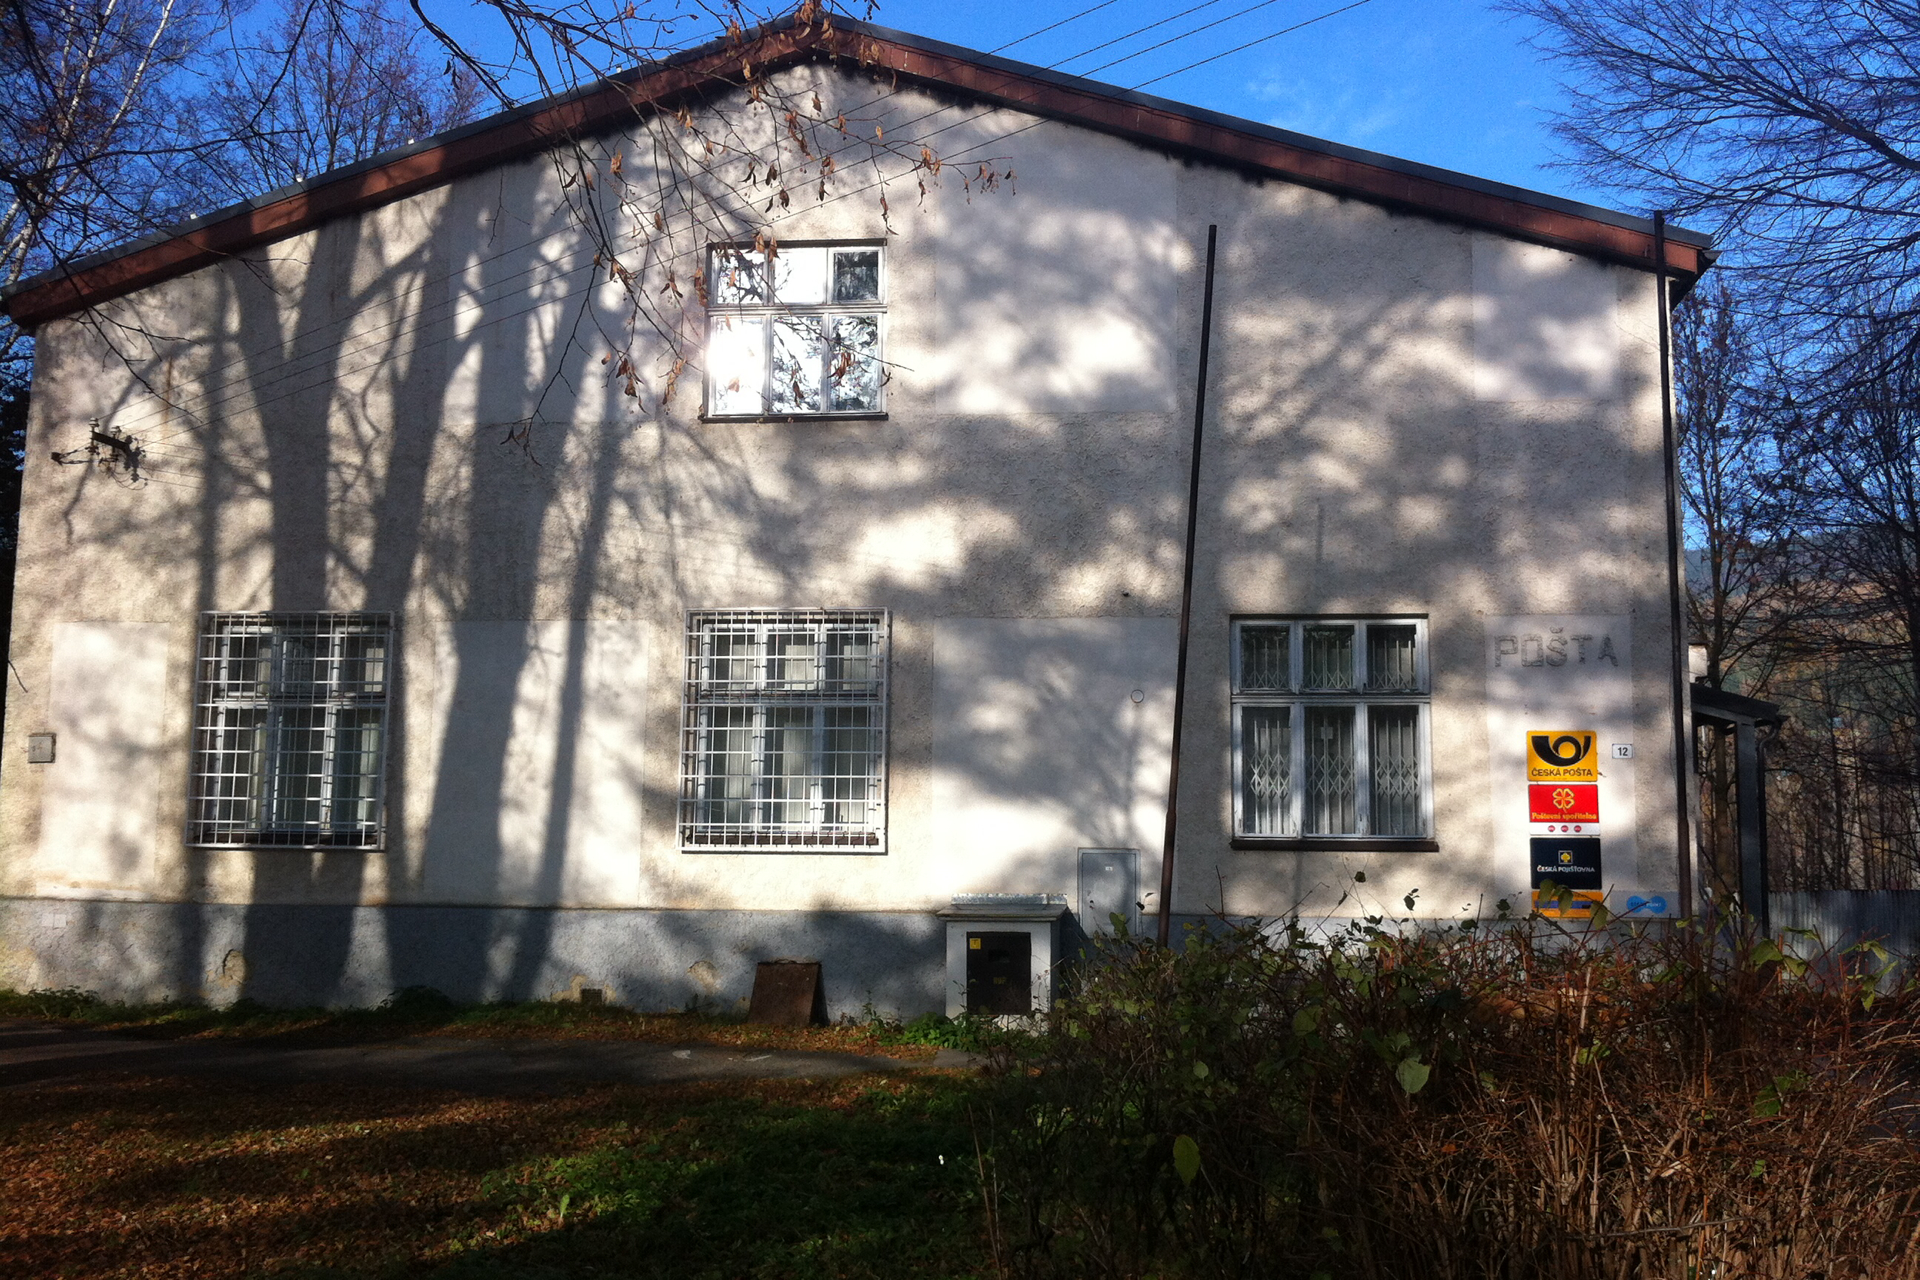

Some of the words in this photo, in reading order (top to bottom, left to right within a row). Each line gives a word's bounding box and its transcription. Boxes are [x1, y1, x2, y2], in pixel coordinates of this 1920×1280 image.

[1494, 627, 1618, 667] POŠTA
[1617, 747, 1628, 756] 12
[1531, 767, 1561, 776] ČESKÁ
[1563, 767, 1593, 776] POŠTA
